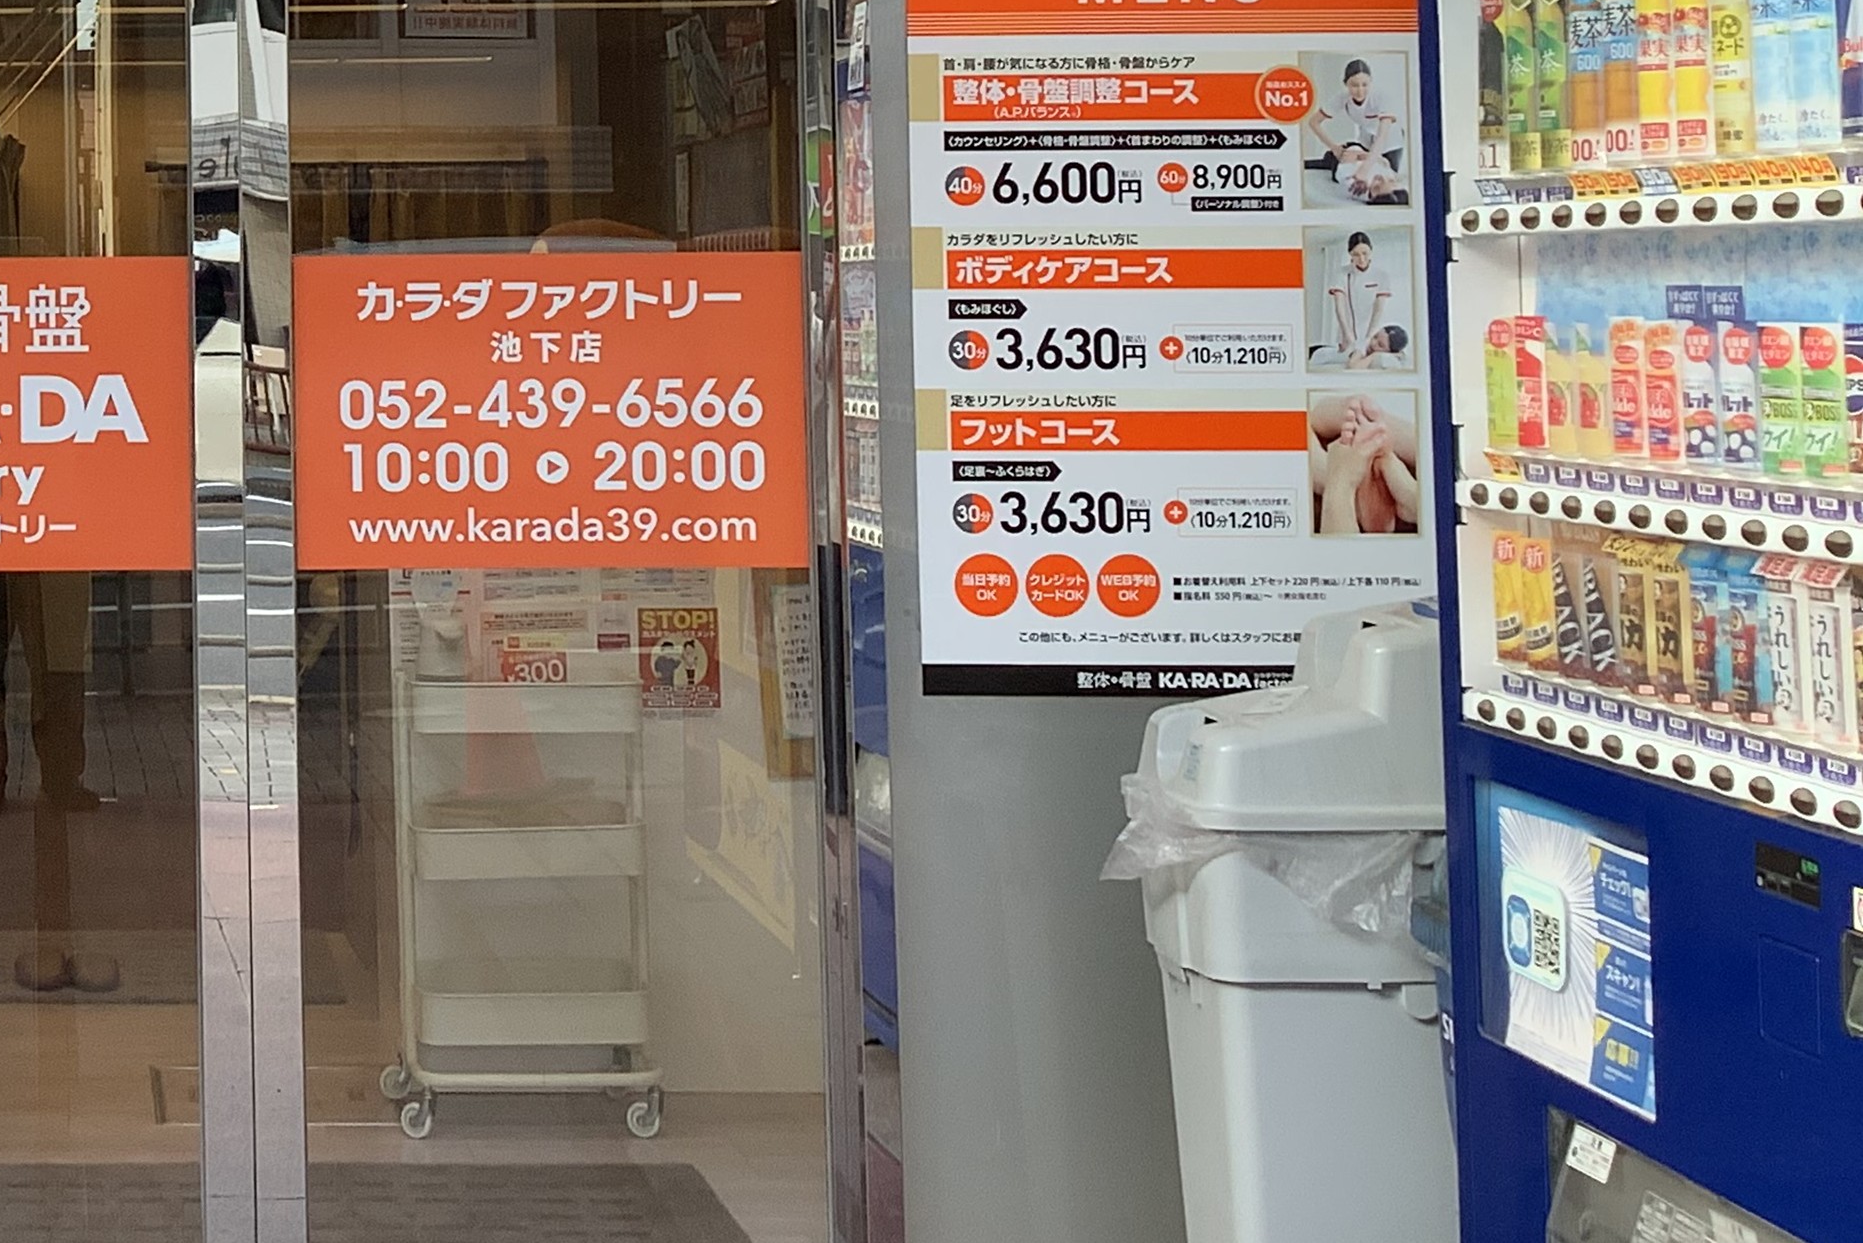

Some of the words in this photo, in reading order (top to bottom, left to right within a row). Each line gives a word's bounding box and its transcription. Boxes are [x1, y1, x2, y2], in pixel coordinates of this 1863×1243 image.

[1603, 3, 1635, 37] 麦茶
[1571, 13, 1603, 48] 麦茶
[1265, 90, 1309, 108] No.1
[948, 176, 984, 196] 40分
[1192, 164, 1282, 190] 8,900円
[947, 233, 1139, 246] カラダをリフレッシュしたい方に
[956, 256, 1173, 284] ボディケアコース
[489, 330, 603, 364] 池下店
[952, 341, 987, 360] 30分
[339, 378, 765, 430] 052-439-6566
[950, 394, 1117, 408] 足をリフレッシュしたい方に
[960, 417, 1121, 446] フットコース
[342, 441, 510, 494] 10:00
[593, 439, 767, 492] 20:00
[956, 504, 992, 523] 30分
[348, 506, 759, 545] www.karada39.com
[962, 574, 1011, 587] 当日予約
[1029, 573, 1086, 587] クレジット
[1100, 574, 1157, 587] WEB予約
[976, 589, 997, 601] OK
[1031, 589, 1085, 602] カードOK
[1118, 590, 1139, 601] OK
[641, 610, 716, 630] STOP!
